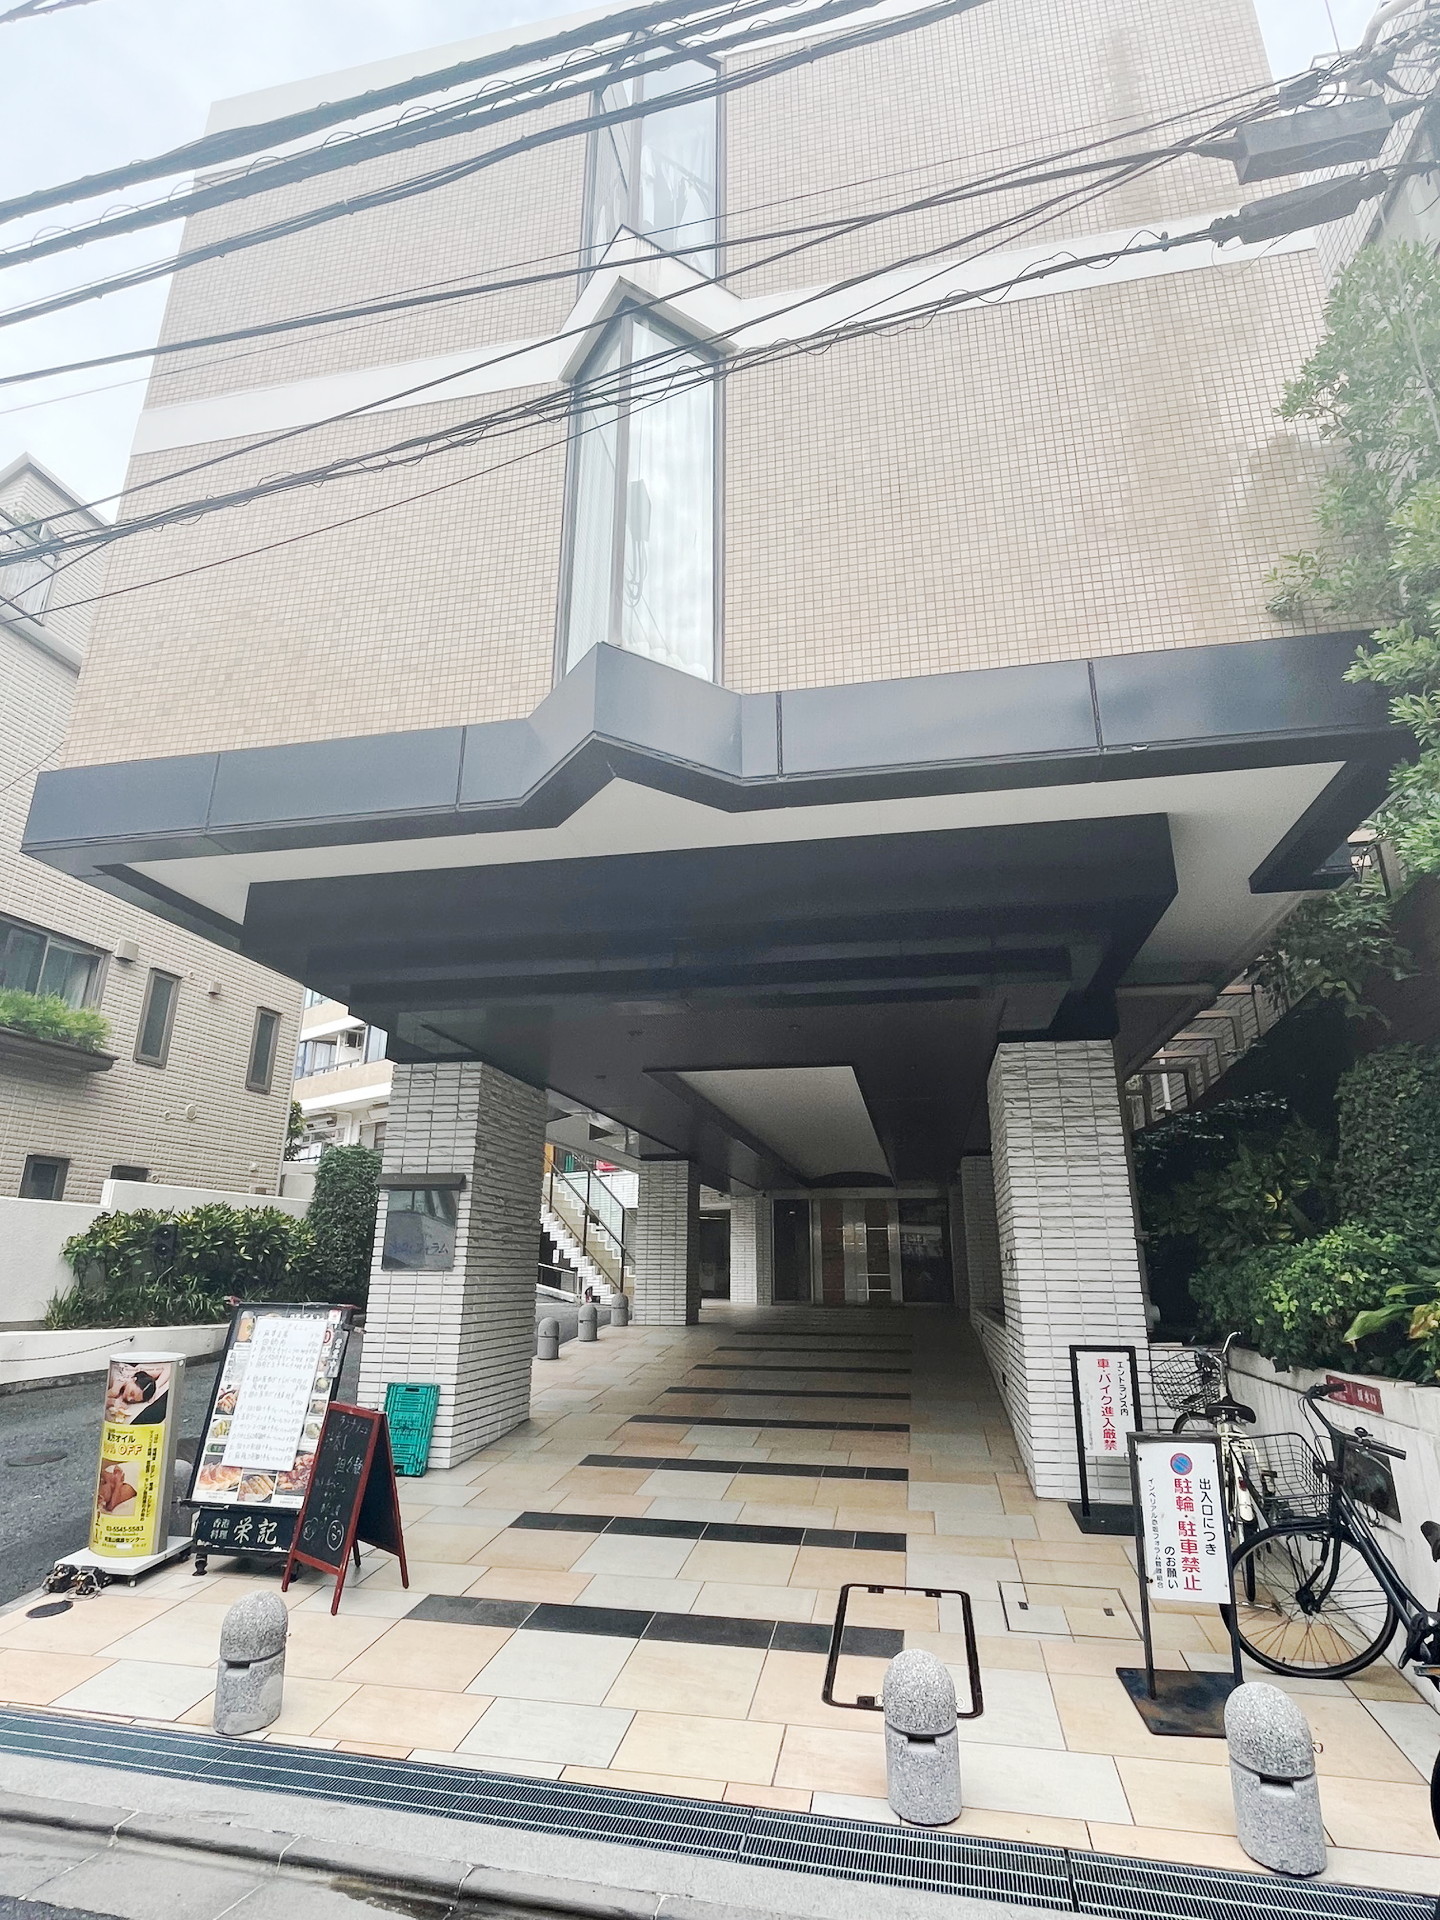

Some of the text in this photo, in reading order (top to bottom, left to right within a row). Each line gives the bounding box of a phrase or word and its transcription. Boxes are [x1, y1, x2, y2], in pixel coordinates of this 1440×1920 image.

[1096, 1358, 1118, 1451] 車・バイク進入厳禁
[1116, 1361, 1129, 1416] エントランス内
[118, 1444, 142, 1456] OFF
[210, 1529, 229, 1540] 料理
[233, 1516, 278, 1545] 栄記
[1174, 1478, 1202, 1591] 駐輪・駐車禁止
[1199, 1478, 1217, 1556] 出入口につき
[1164, 1546, 1179, 1590] のお願い
